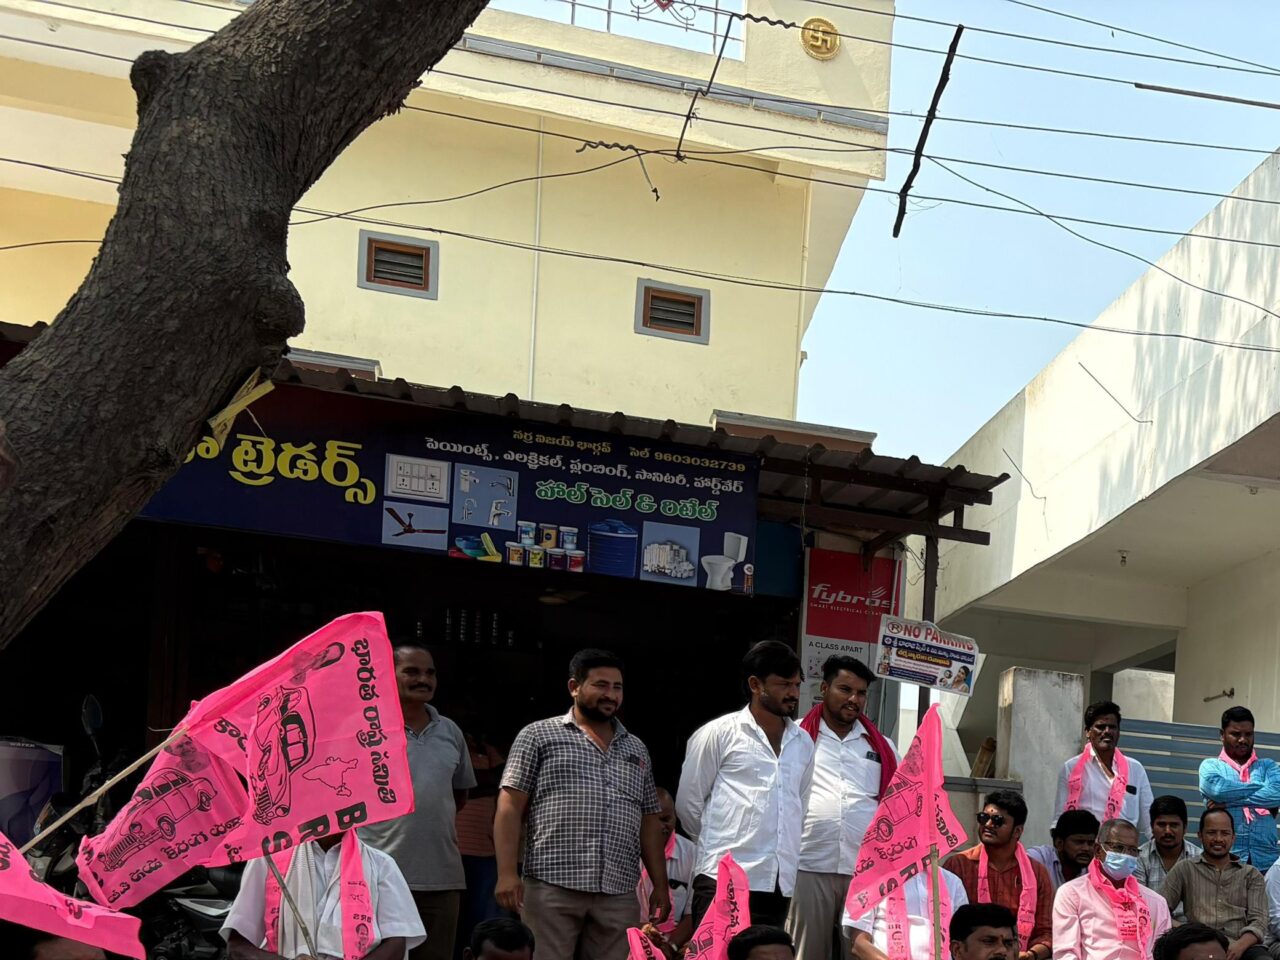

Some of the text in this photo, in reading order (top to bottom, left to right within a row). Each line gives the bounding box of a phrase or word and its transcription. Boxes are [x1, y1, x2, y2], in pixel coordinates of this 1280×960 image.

[654, 452, 746, 472] 9603032739
[812, 584, 896, 608] fybros
[903, 624, 920, 638] NO
[815, 642, 839, 650] CLASS
[840, 645, 864, 653] APART
[351, 638, 397, 804] భారత రాష్ట్ర సమితి
